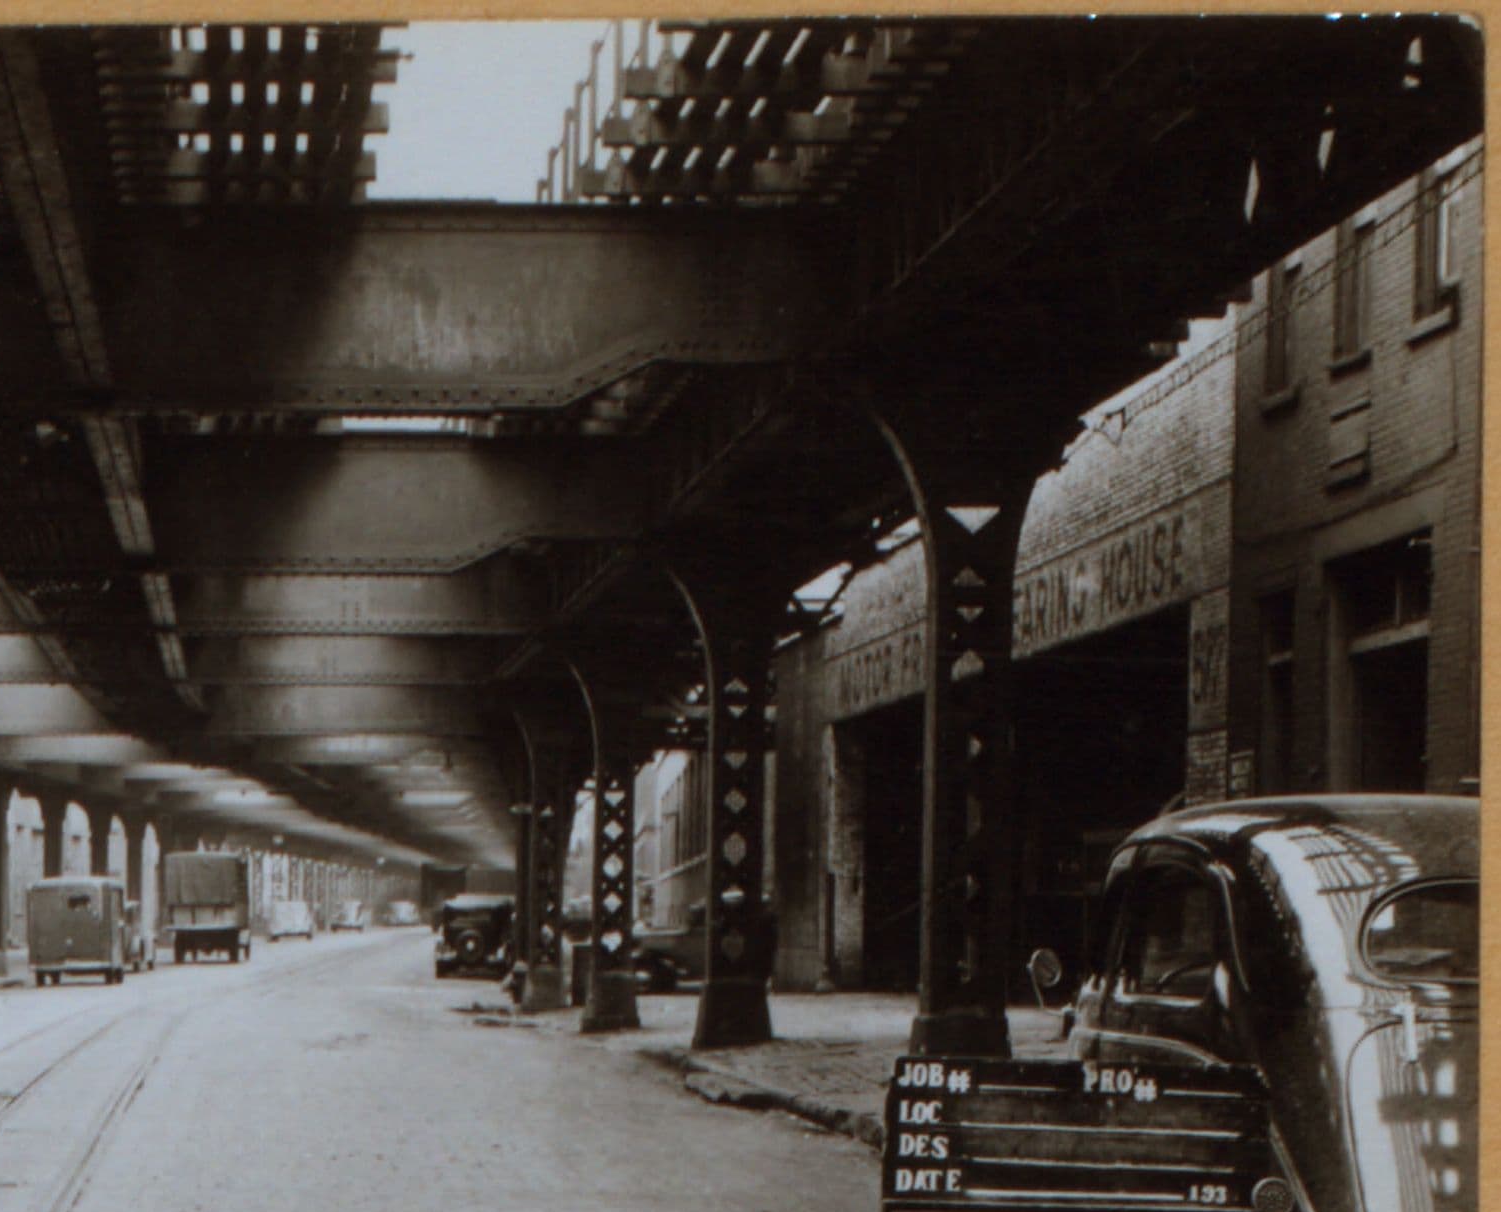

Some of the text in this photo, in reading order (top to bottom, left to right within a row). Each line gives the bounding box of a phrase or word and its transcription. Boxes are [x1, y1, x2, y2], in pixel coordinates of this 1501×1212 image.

[840, 641, 892, 706] MOTOR
[1098, 515, 1185, 619] HOUSE
[900, 1100, 942, 1124] LOC
[899, 1133, 949, 1159] DES
[895, 1168, 1227, 1204] DATE 193
